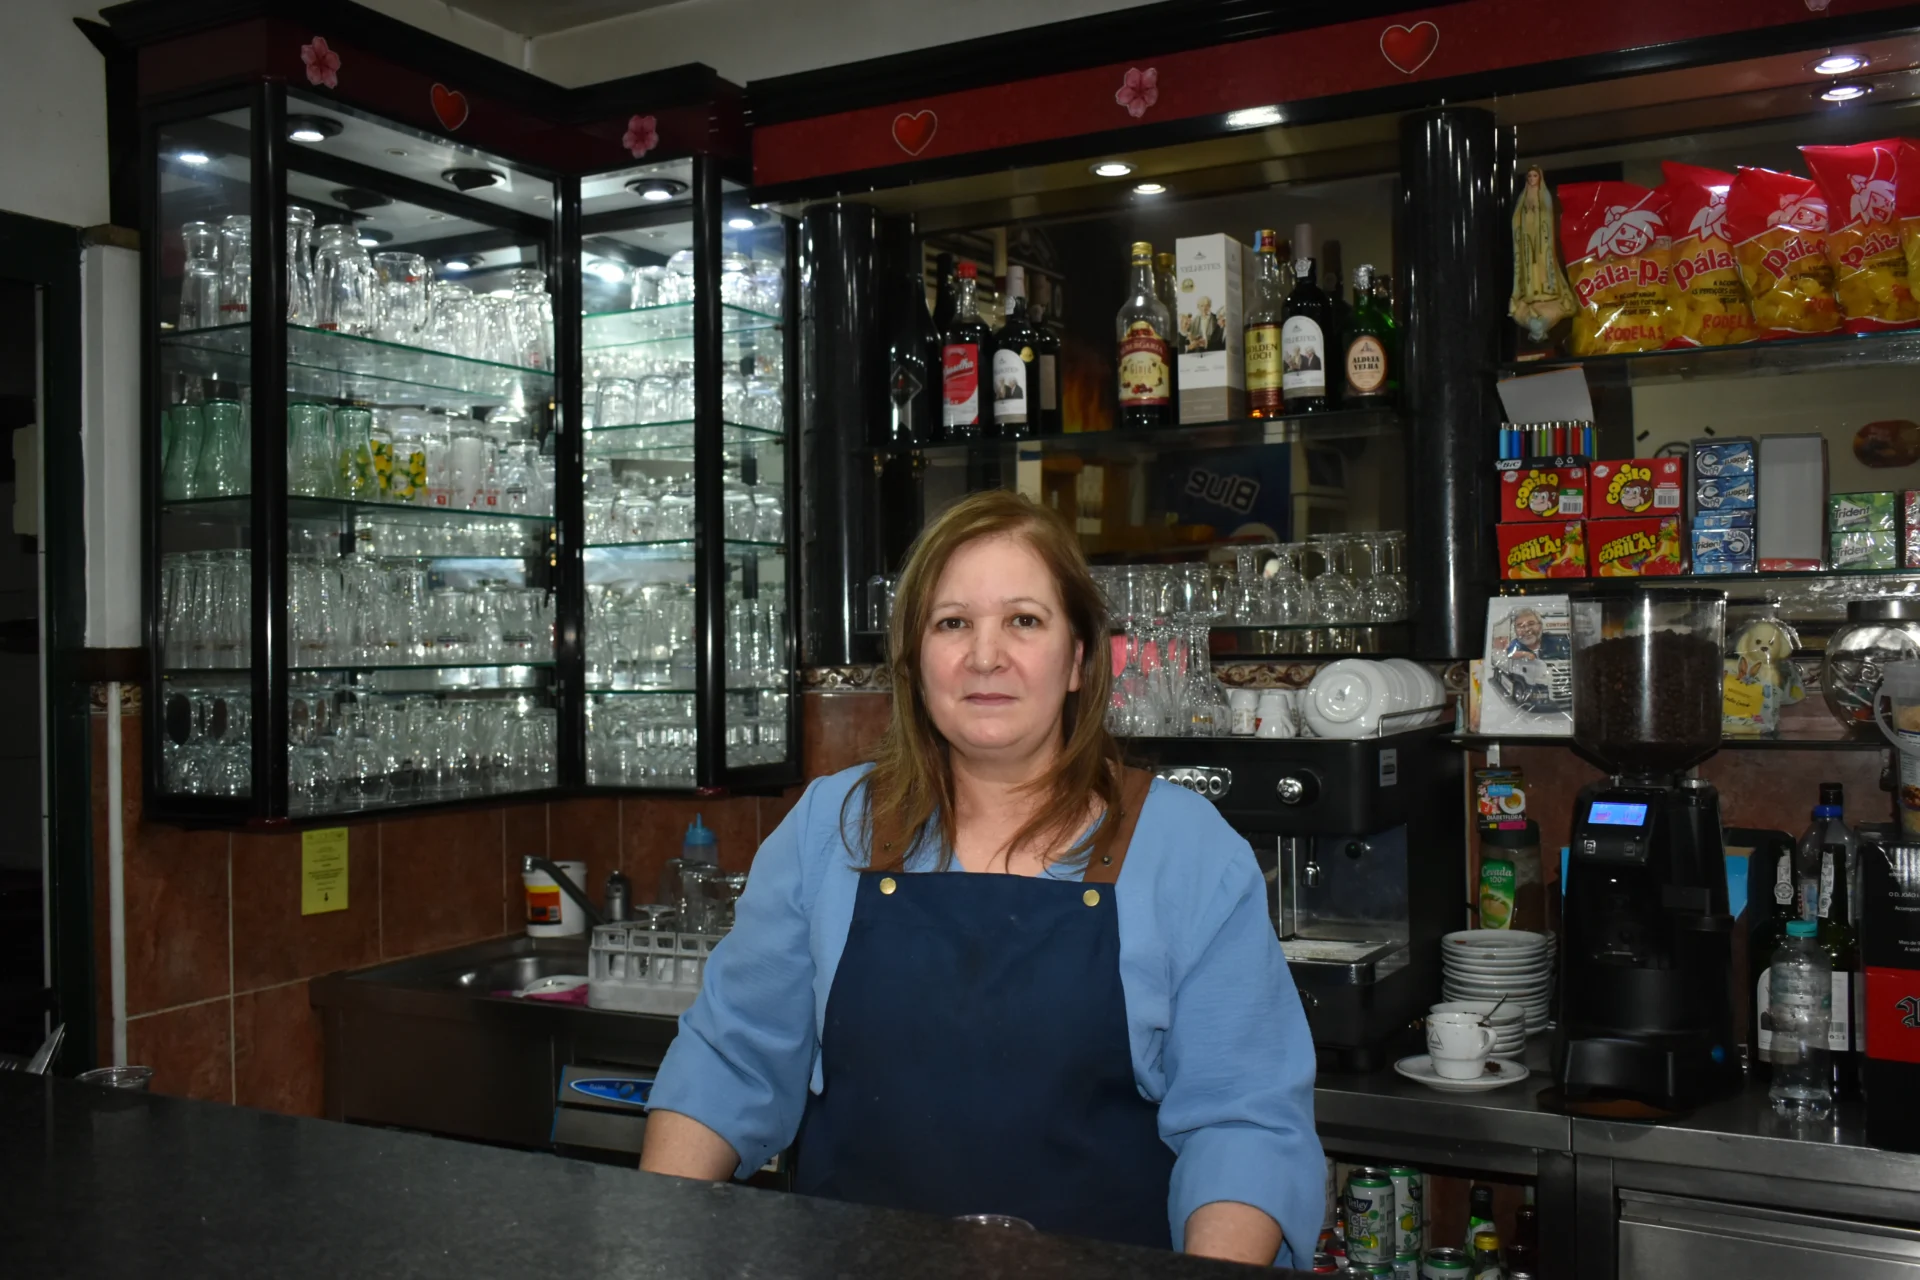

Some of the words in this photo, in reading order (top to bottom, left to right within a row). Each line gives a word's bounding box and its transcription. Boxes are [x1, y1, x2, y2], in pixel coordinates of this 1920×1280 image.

[1250, 352, 1271, 360] LOCH
[1834, 505, 1871, 519] Trident
[1520, 538, 1538, 549] DOCE
[1539, 534, 1550, 543] DE
[1612, 534, 1631, 546] DOCE
[1632, 531, 1644, 540] DE
[1507, 538, 1561, 565] GORILA!
[1599, 534, 1656, 563] GORILA!
[1481, 866, 1513, 877] Cevada
[1348, 1197, 1369, 1211] Tetley
